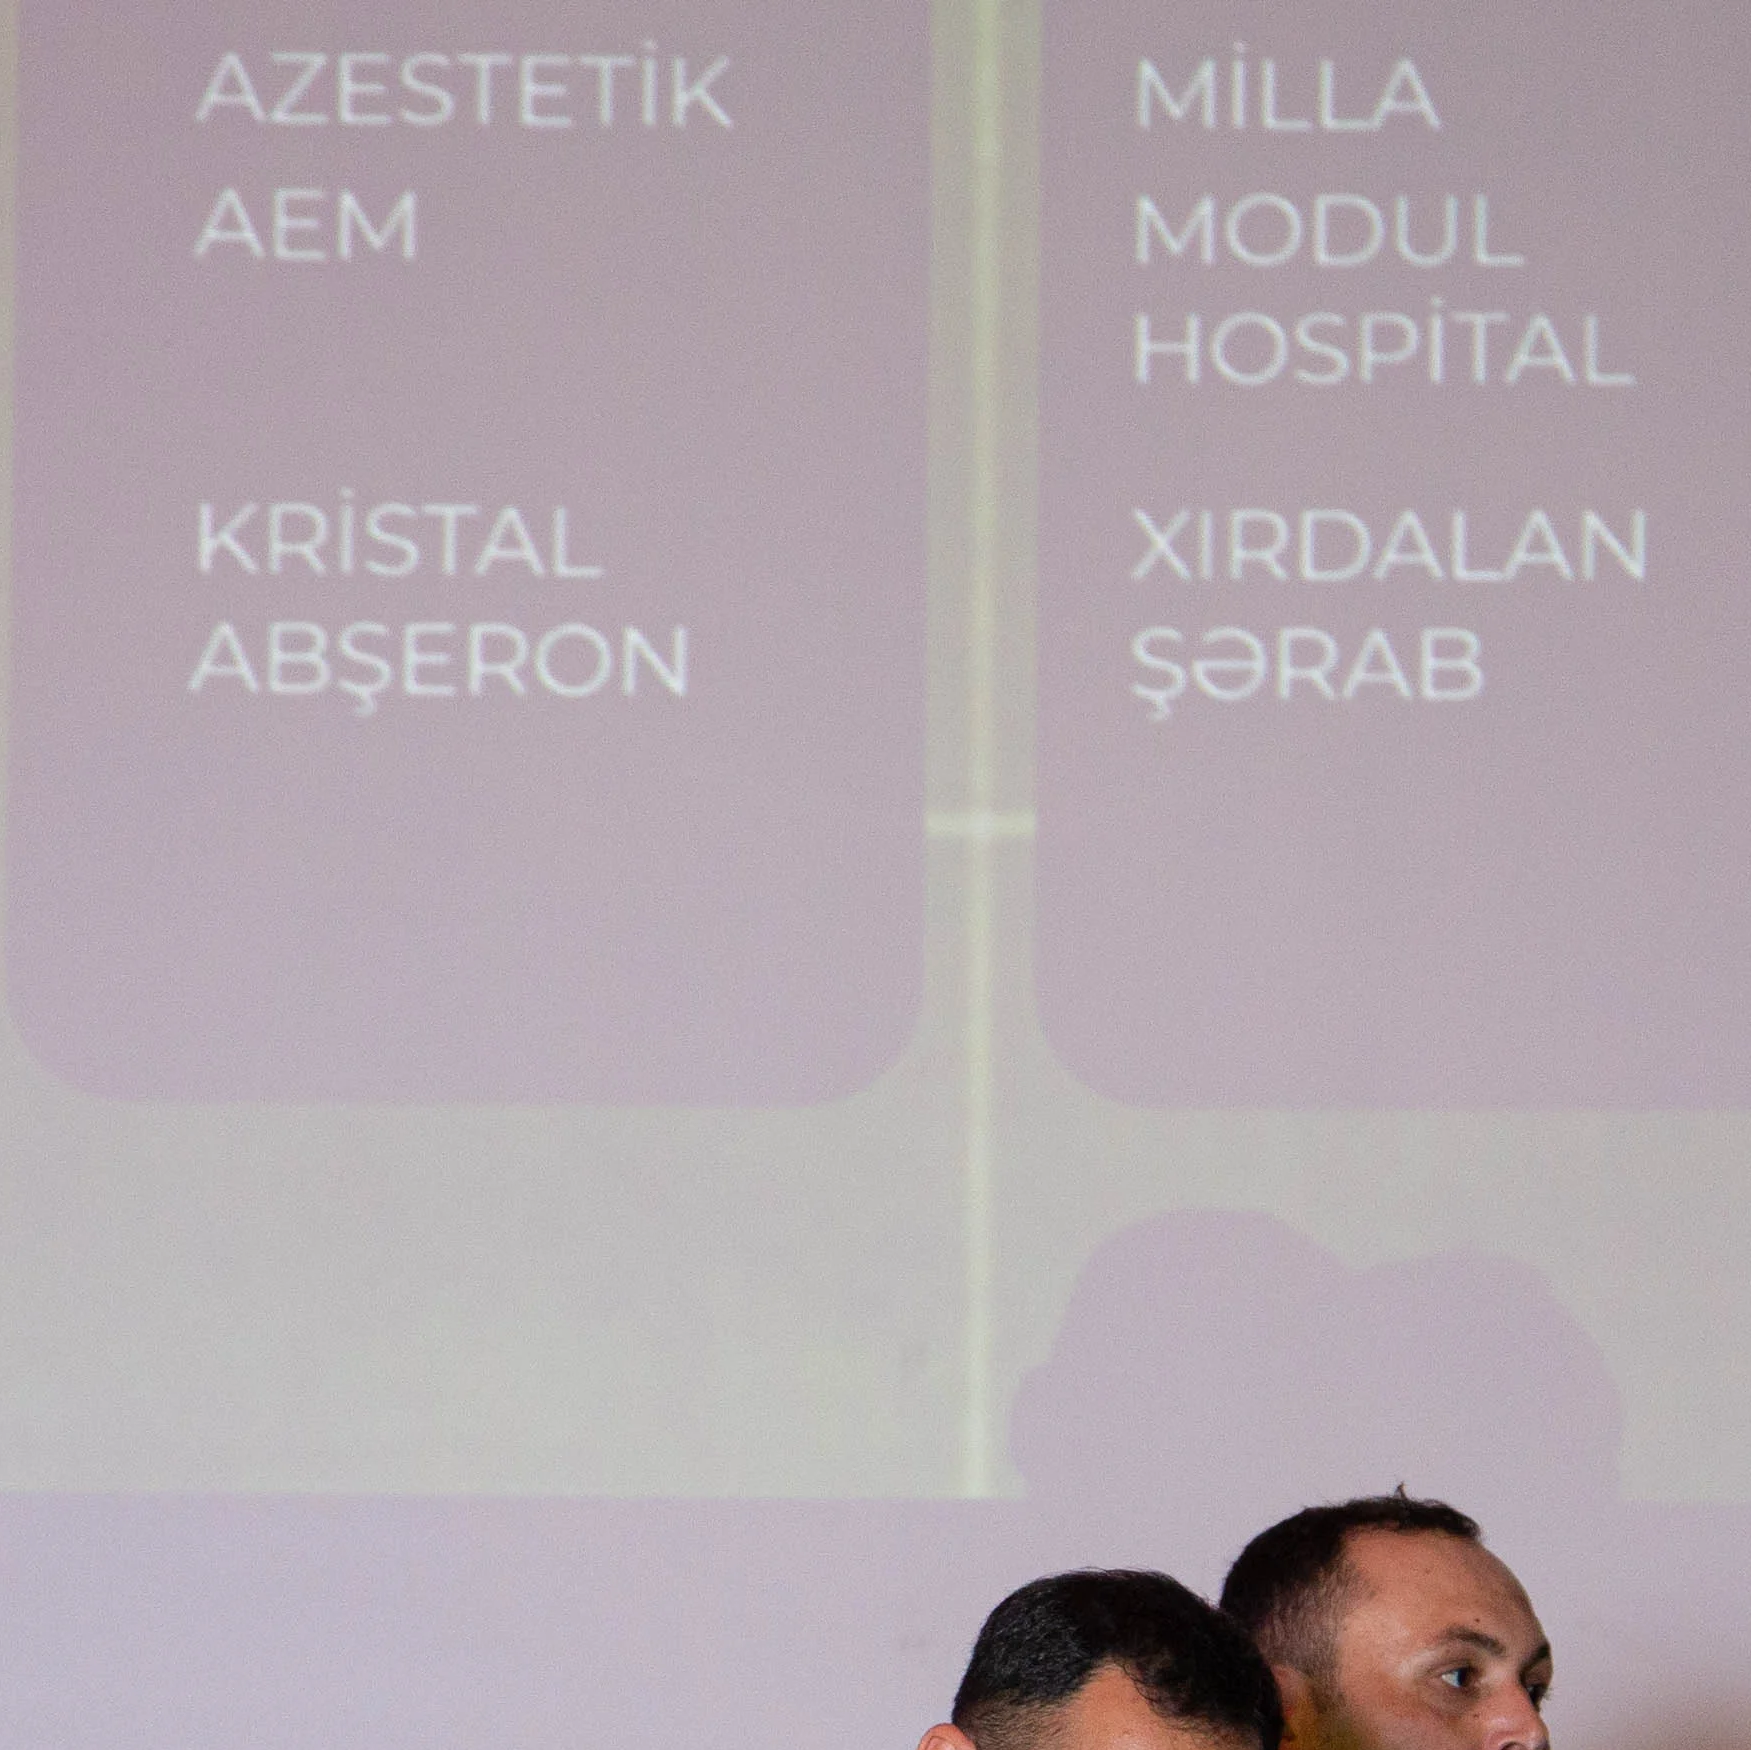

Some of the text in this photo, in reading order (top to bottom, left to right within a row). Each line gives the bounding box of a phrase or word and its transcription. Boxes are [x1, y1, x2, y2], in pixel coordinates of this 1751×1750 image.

[195, 40, 734, 128] AZESTETİK
[1135, 42, 1441, 131] MİLLA
[193, 187, 418, 261] AEM
[1134, 193, 1524, 268] MODUL
[1133, 297, 1635, 387] HOSPİTAL
[197, 488, 604, 578] KRİSTAL
[1131, 508, 1646, 583] XIRDALAN
[188, 621, 689, 716] ABŞERON
[1131, 626, 1484, 720] ŞƏRAB
